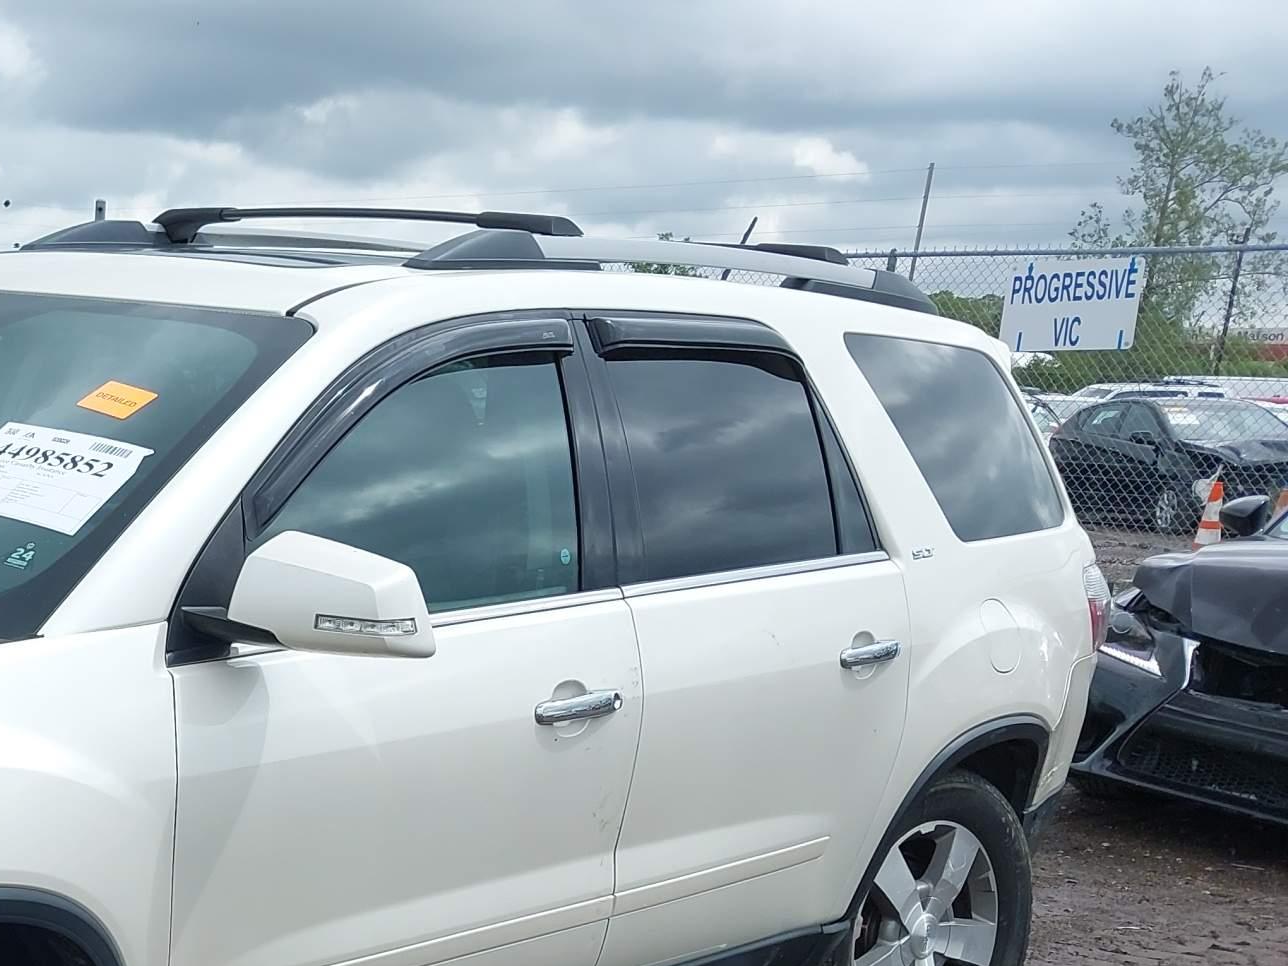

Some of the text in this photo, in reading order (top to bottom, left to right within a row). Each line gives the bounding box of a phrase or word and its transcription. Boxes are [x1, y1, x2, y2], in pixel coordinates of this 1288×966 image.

[1010, 268, 1138, 304] PROGRESSIVE
[1053, 316, 1081, 347] VIC
[95, 391, 137, 408] DETAILED
[11, 547, 35, 561] 24
